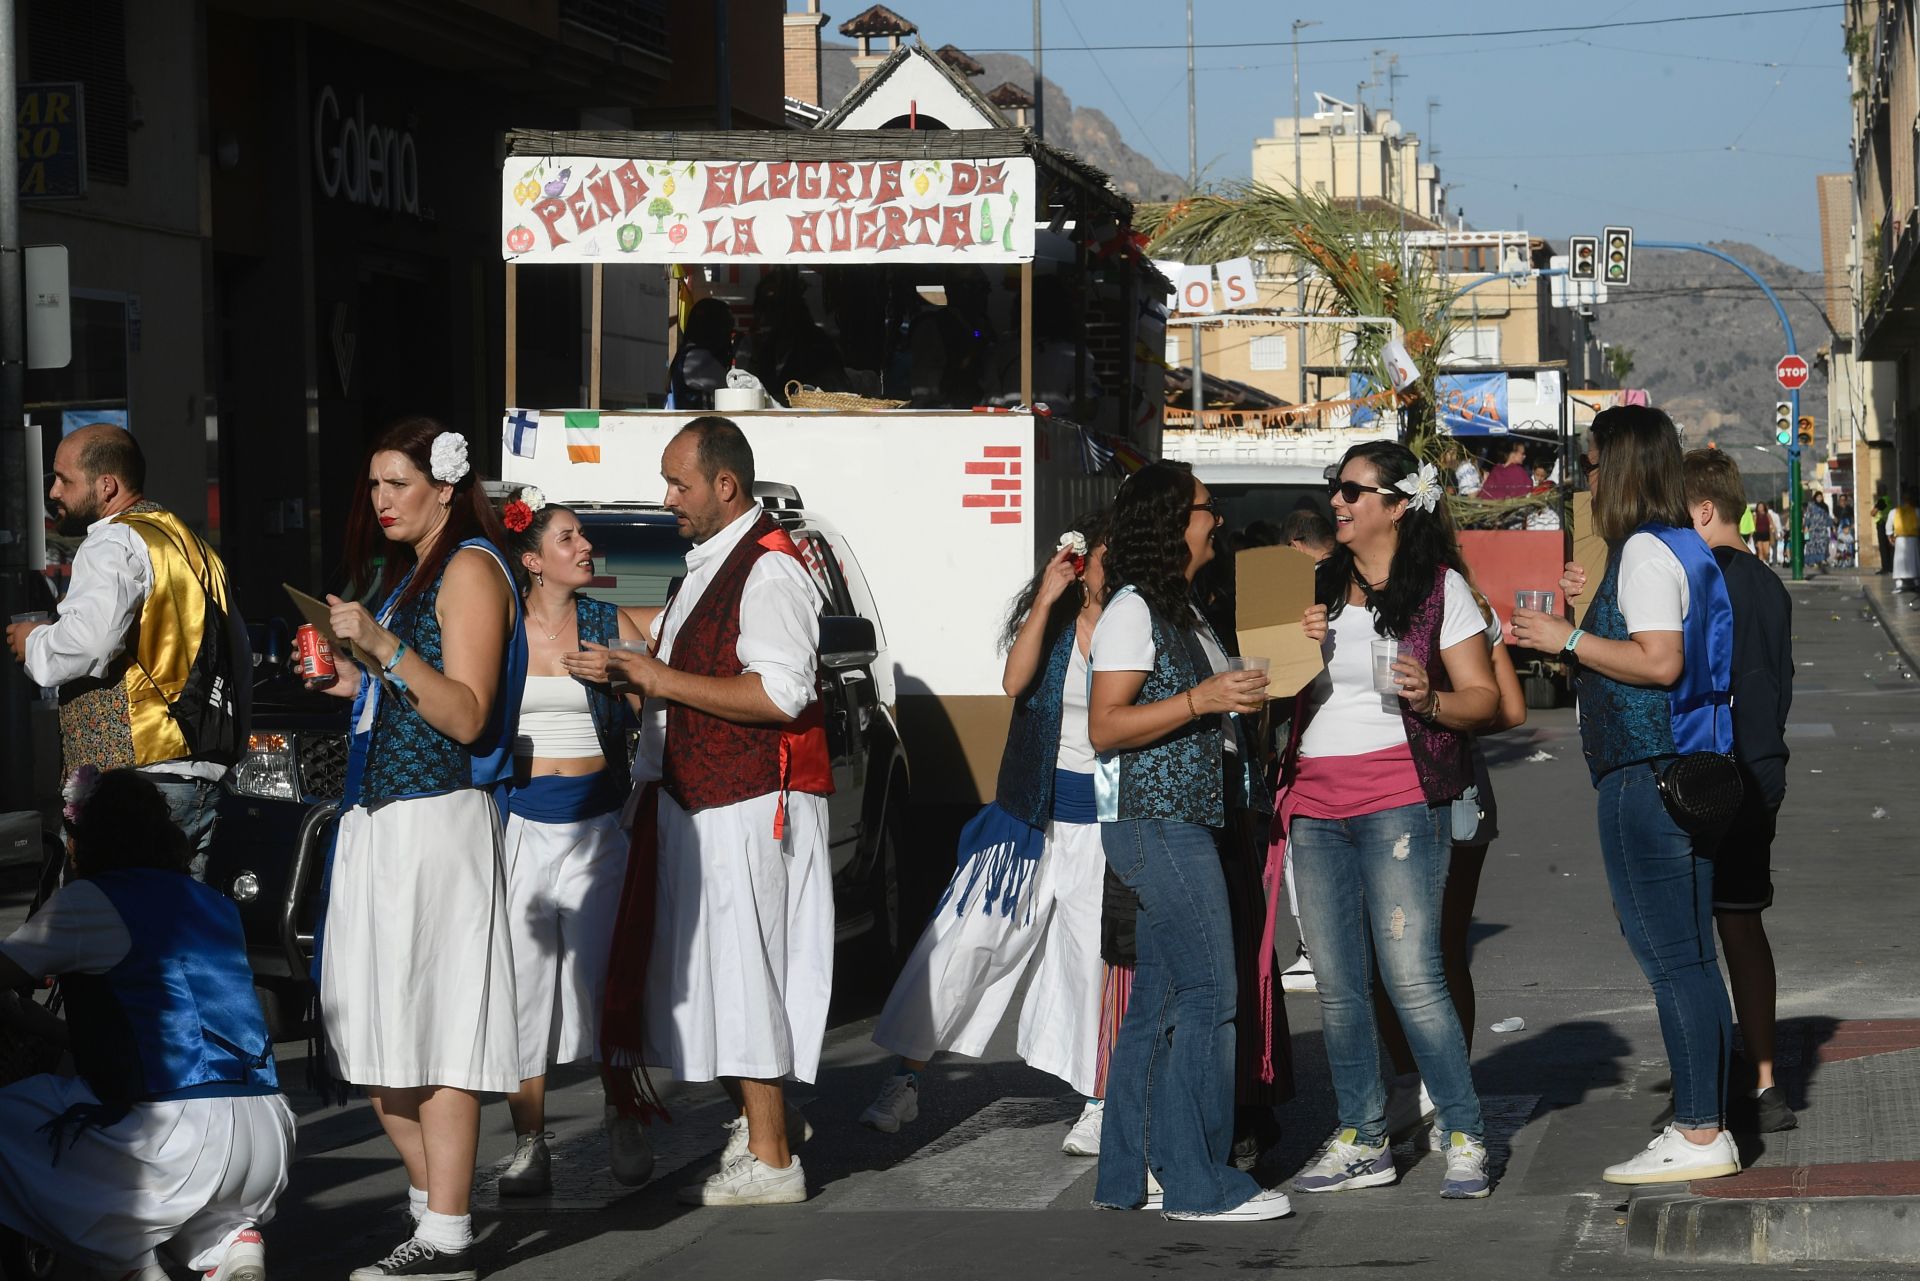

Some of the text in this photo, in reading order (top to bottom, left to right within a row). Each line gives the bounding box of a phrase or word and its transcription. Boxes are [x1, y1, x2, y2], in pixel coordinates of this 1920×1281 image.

[531, 159, 1010, 251] PEÑA ALEGRIA DE
[701, 203, 976, 257] LA HUERTA
[1779, 367, 1806, 377] STOP
